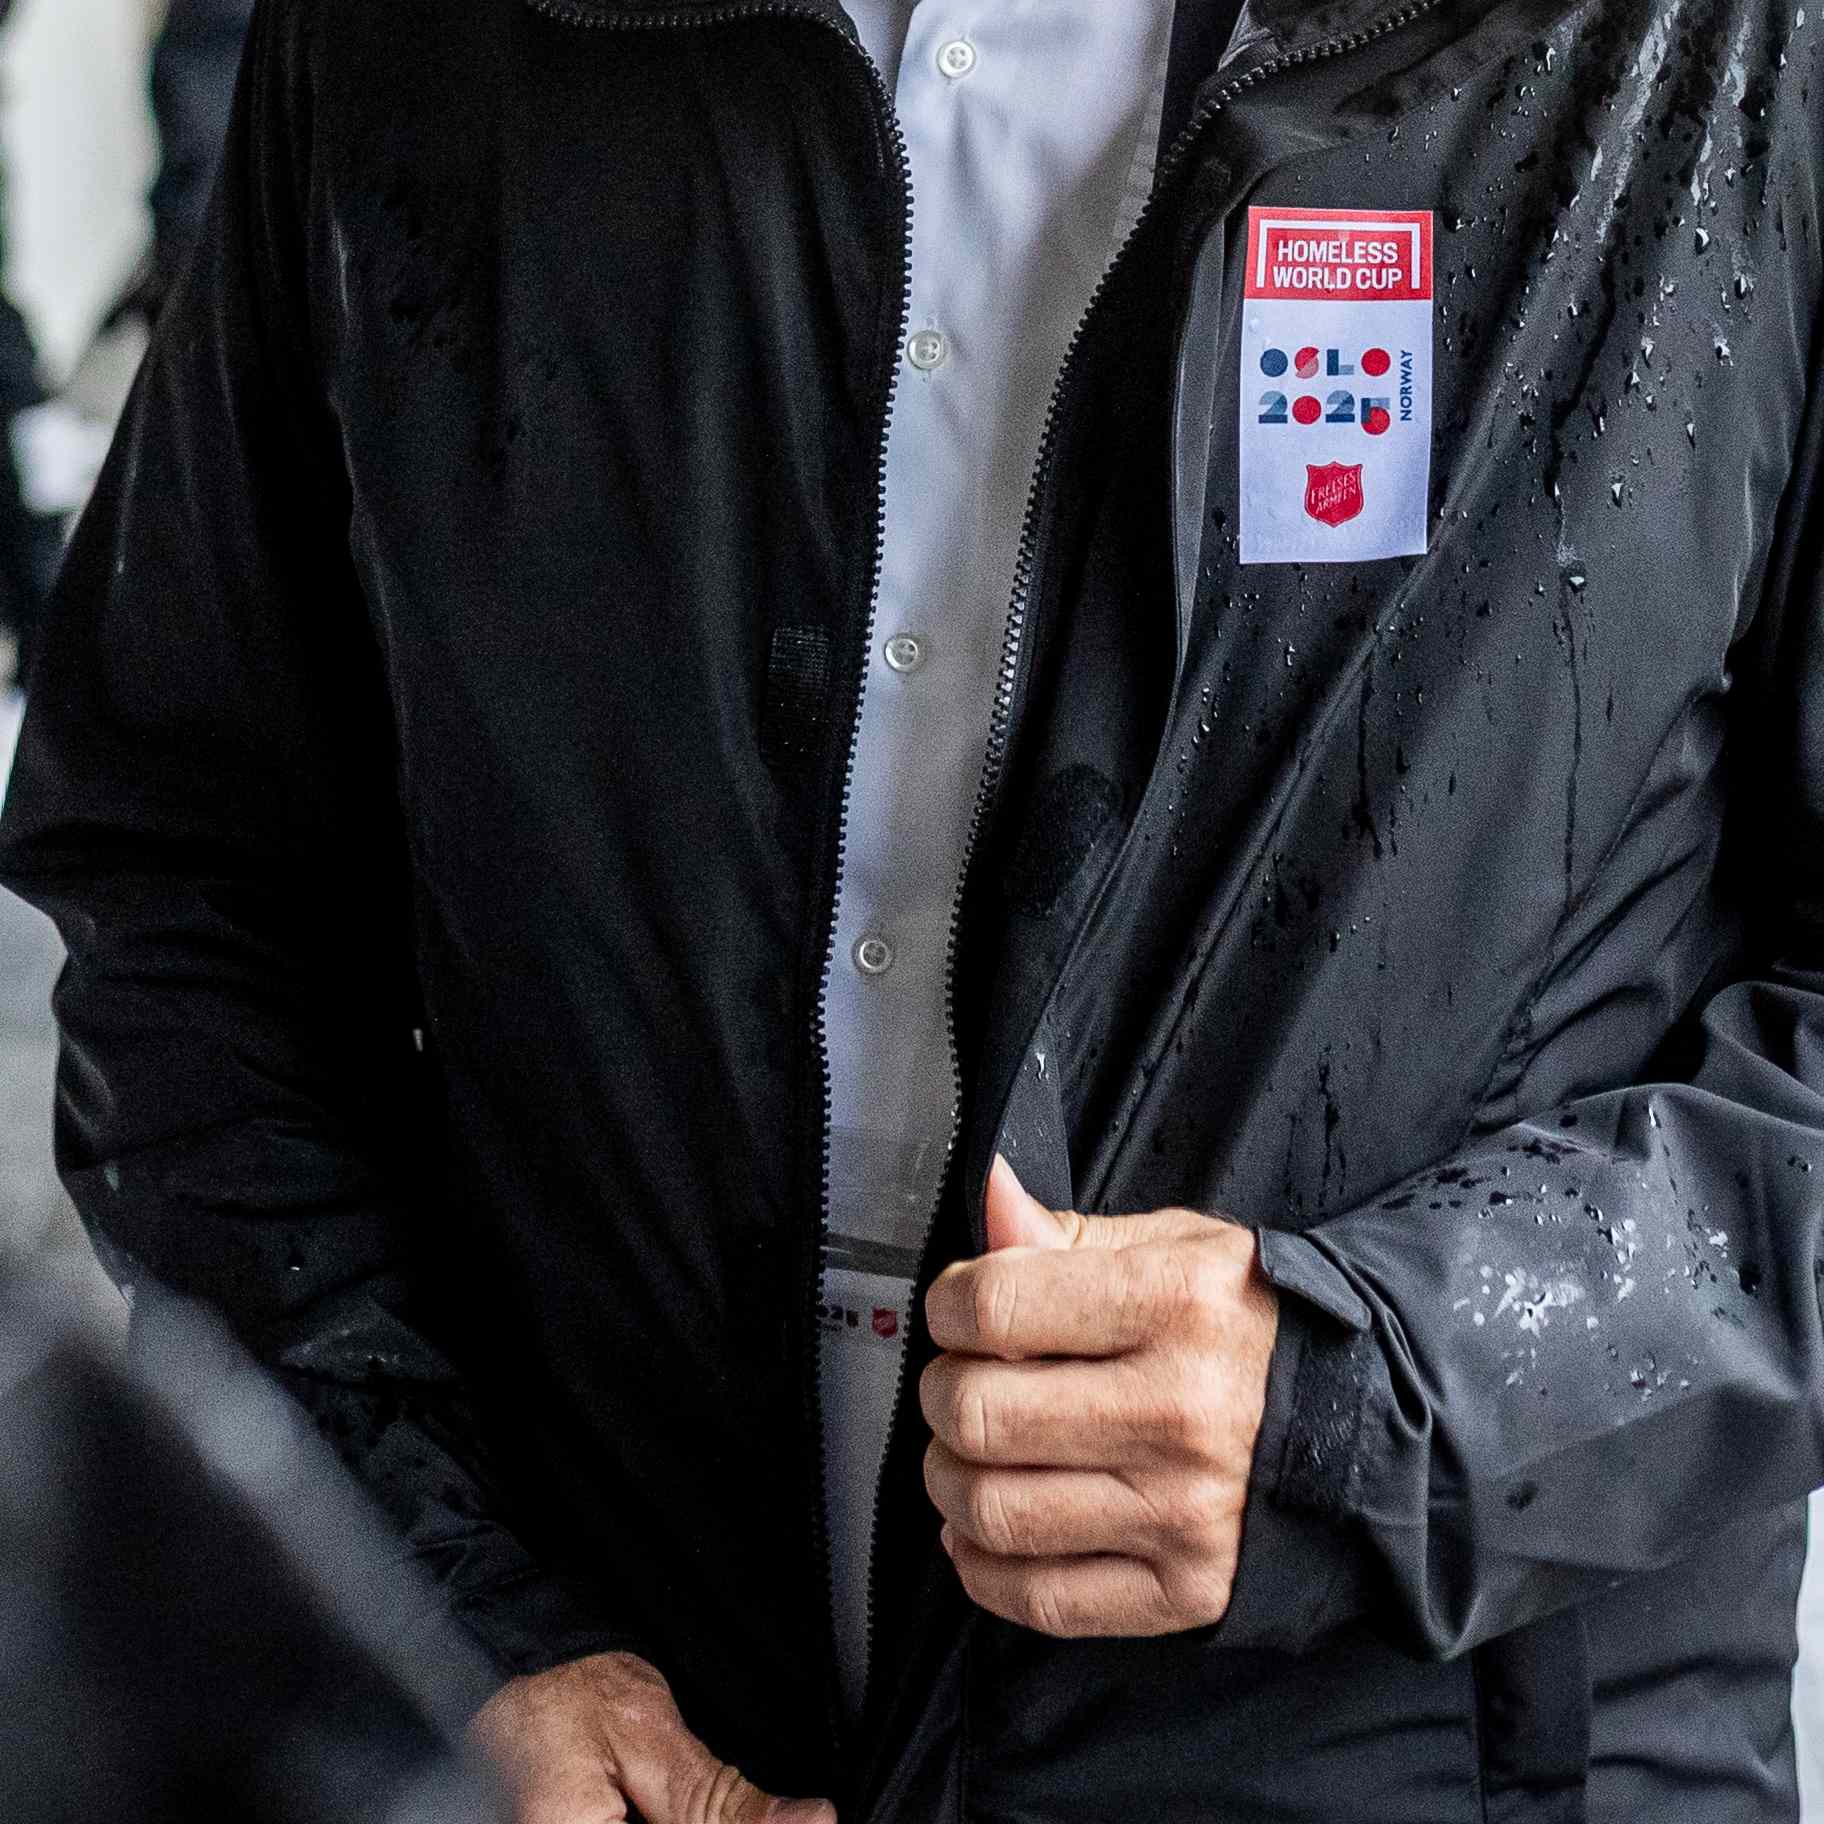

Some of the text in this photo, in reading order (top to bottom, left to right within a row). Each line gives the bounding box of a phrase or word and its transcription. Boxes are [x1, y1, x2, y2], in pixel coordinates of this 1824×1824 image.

[1277, 239, 1398, 264] HOMELESS
[1273, 266, 1402, 289] WORLD CUP
[1259, 346, 1391, 379] OSLO
[1400, 349, 1413, 422] NORWAY
[1258, 389, 1391, 436] 2025
